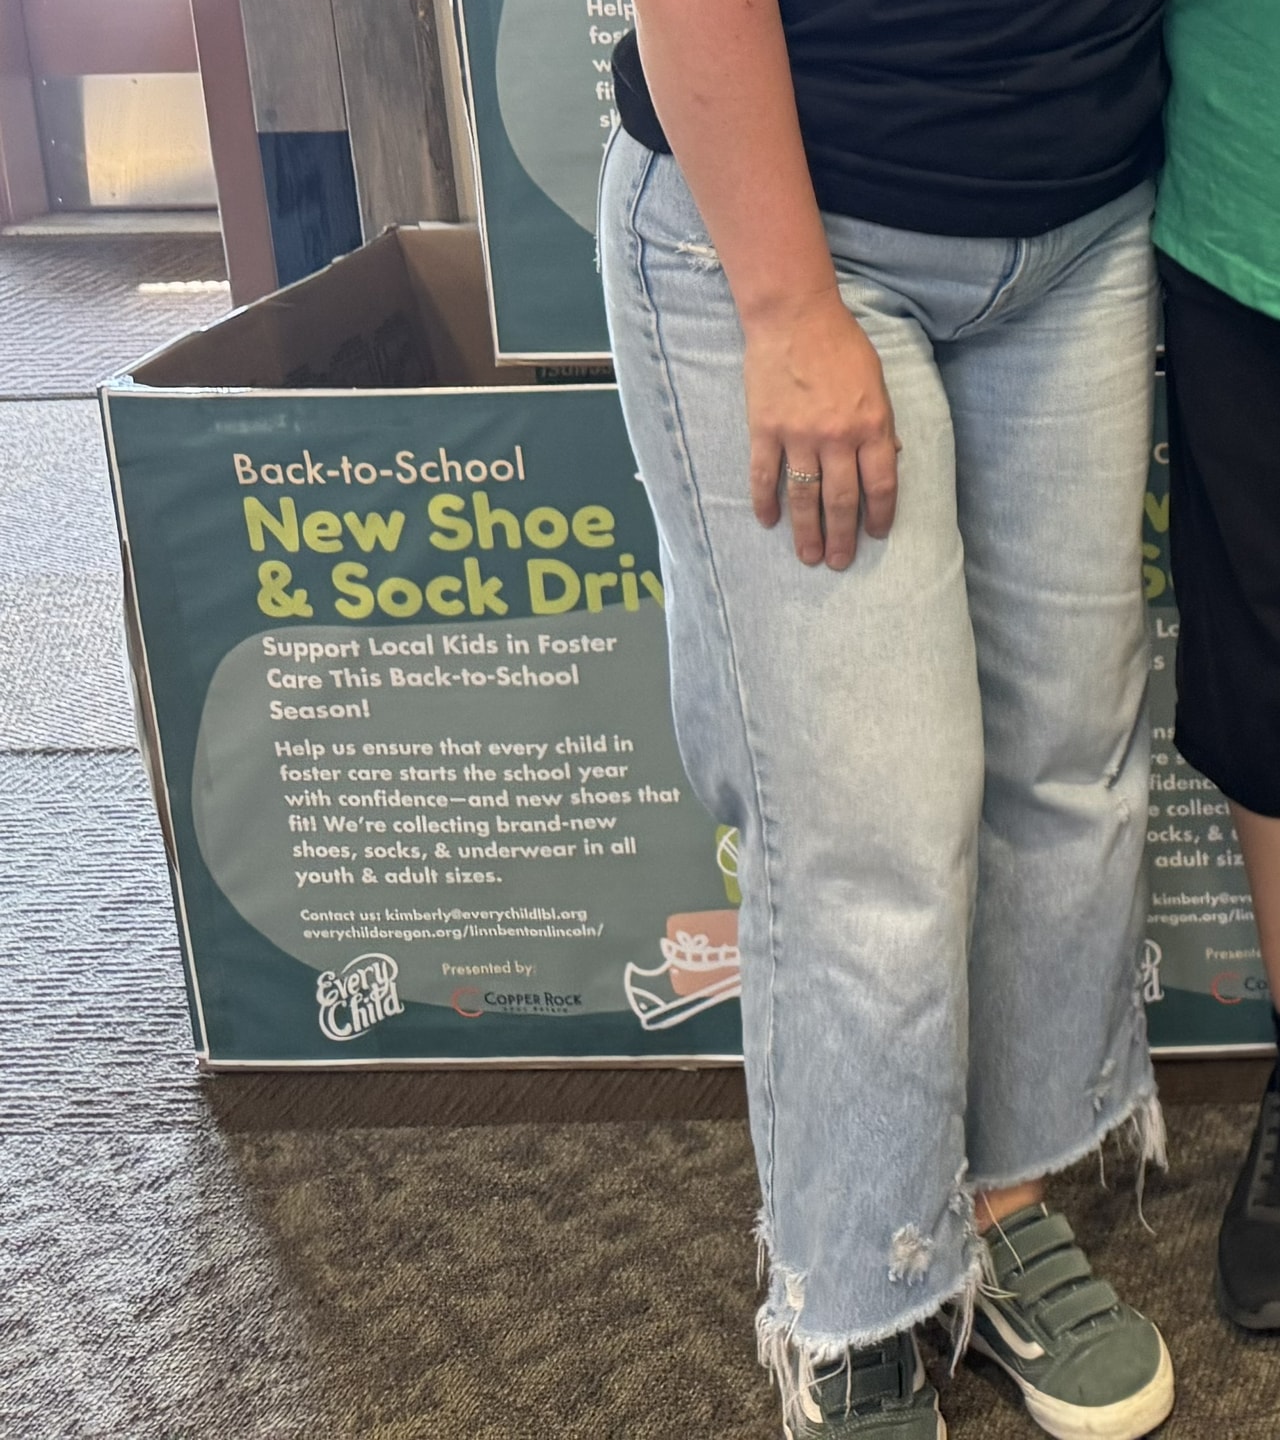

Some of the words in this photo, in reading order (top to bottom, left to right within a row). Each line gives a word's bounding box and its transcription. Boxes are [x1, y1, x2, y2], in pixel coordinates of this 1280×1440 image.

[233, 446, 525, 486] Back-to-School
[244, 496, 405, 553] New
[428, 491, 615, 551] Shoe
[256, 560, 314, 619] &
[332, 556, 508, 619] Sock
[526, 553, 664, 616] Driv
[263, 636, 360, 663] Support
[369, 634, 434, 657] Local
[443, 634, 498, 656] Kids
[507, 634, 529, 655] in
[538, 634, 617, 654] Foster
[267, 668, 323, 689] Care
[330, 667, 382, 688] This
[389, 664, 579, 687] Back-to-School
[270, 699, 371, 720] Season!
[275, 739, 326, 760] Help
[332, 743, 356, 755] us
[363, 742, 433, 755] ensure
[440, 737, 482, 755] that
[488, 743, 548, 760] every
[555, 735, 608, 754] child
[613, 735, 634, 753] in
[280, 765, 341, 781] foster
[348, 769, 393, 781] care
[400, 766, 457, 781] starts
[463, 763, 497, 781] the
[504, 762, 571, 781] school
[578, 765, 628, 783] year
[285, 789, 332, 807] with
[516, 793, 563, 807] new
[570, 787, 632, 805] shoes
[638, 785, 681, 803] that
[288, 814, 317, 832] fit!
[393, 815, 490, 837] collecting
[496, 814, 617, 833] brand-new
[1208, 825, 1223, 841] &
[292, 840, 358, 861] shoes,
[364, 841, 427, 861] socks,
[434, 842, 452, 858] &
[458, 840, 577, 858] underwear
[584, 838, 604, 855] in
[611, 837, 637, 854] all
[1155, 851, 1209, 867] adult
[295, 866, 355, 888] youth
[362, 867, 378, 884] &
[385, 866, 439, 884] adult
[445, 866, 503, 884] sizes.
[300, 909, 355, 922] Contact
[316, 954, 398, 1003] Every
[442, 962, 511, 977] Presented
[318, 982, 405, 1041] Child
